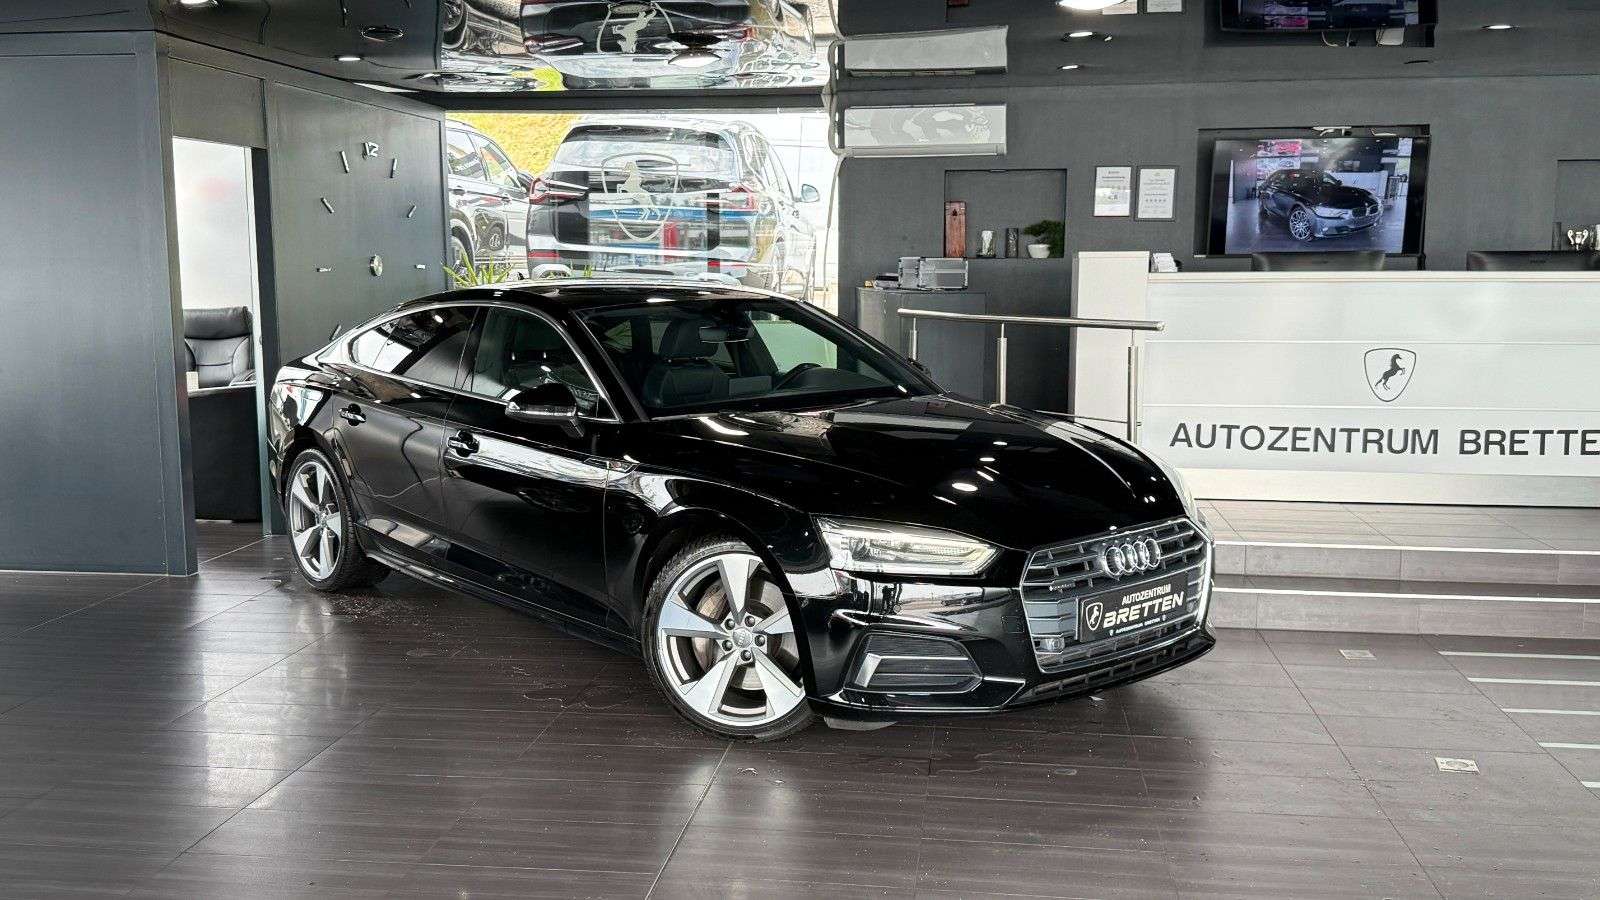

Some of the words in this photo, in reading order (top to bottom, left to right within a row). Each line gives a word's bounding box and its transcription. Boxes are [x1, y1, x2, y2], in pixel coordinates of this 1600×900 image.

[364, 142, 379, 157] 12
[1170, 422, 1439, 455] AUTOZENTRUM
[1459, 429, 1600, 455] BRETTE
[1121, 584, 1172, 605] AUTOZENTRUM
[1103, 591, 1185, 628] BRETTEN
